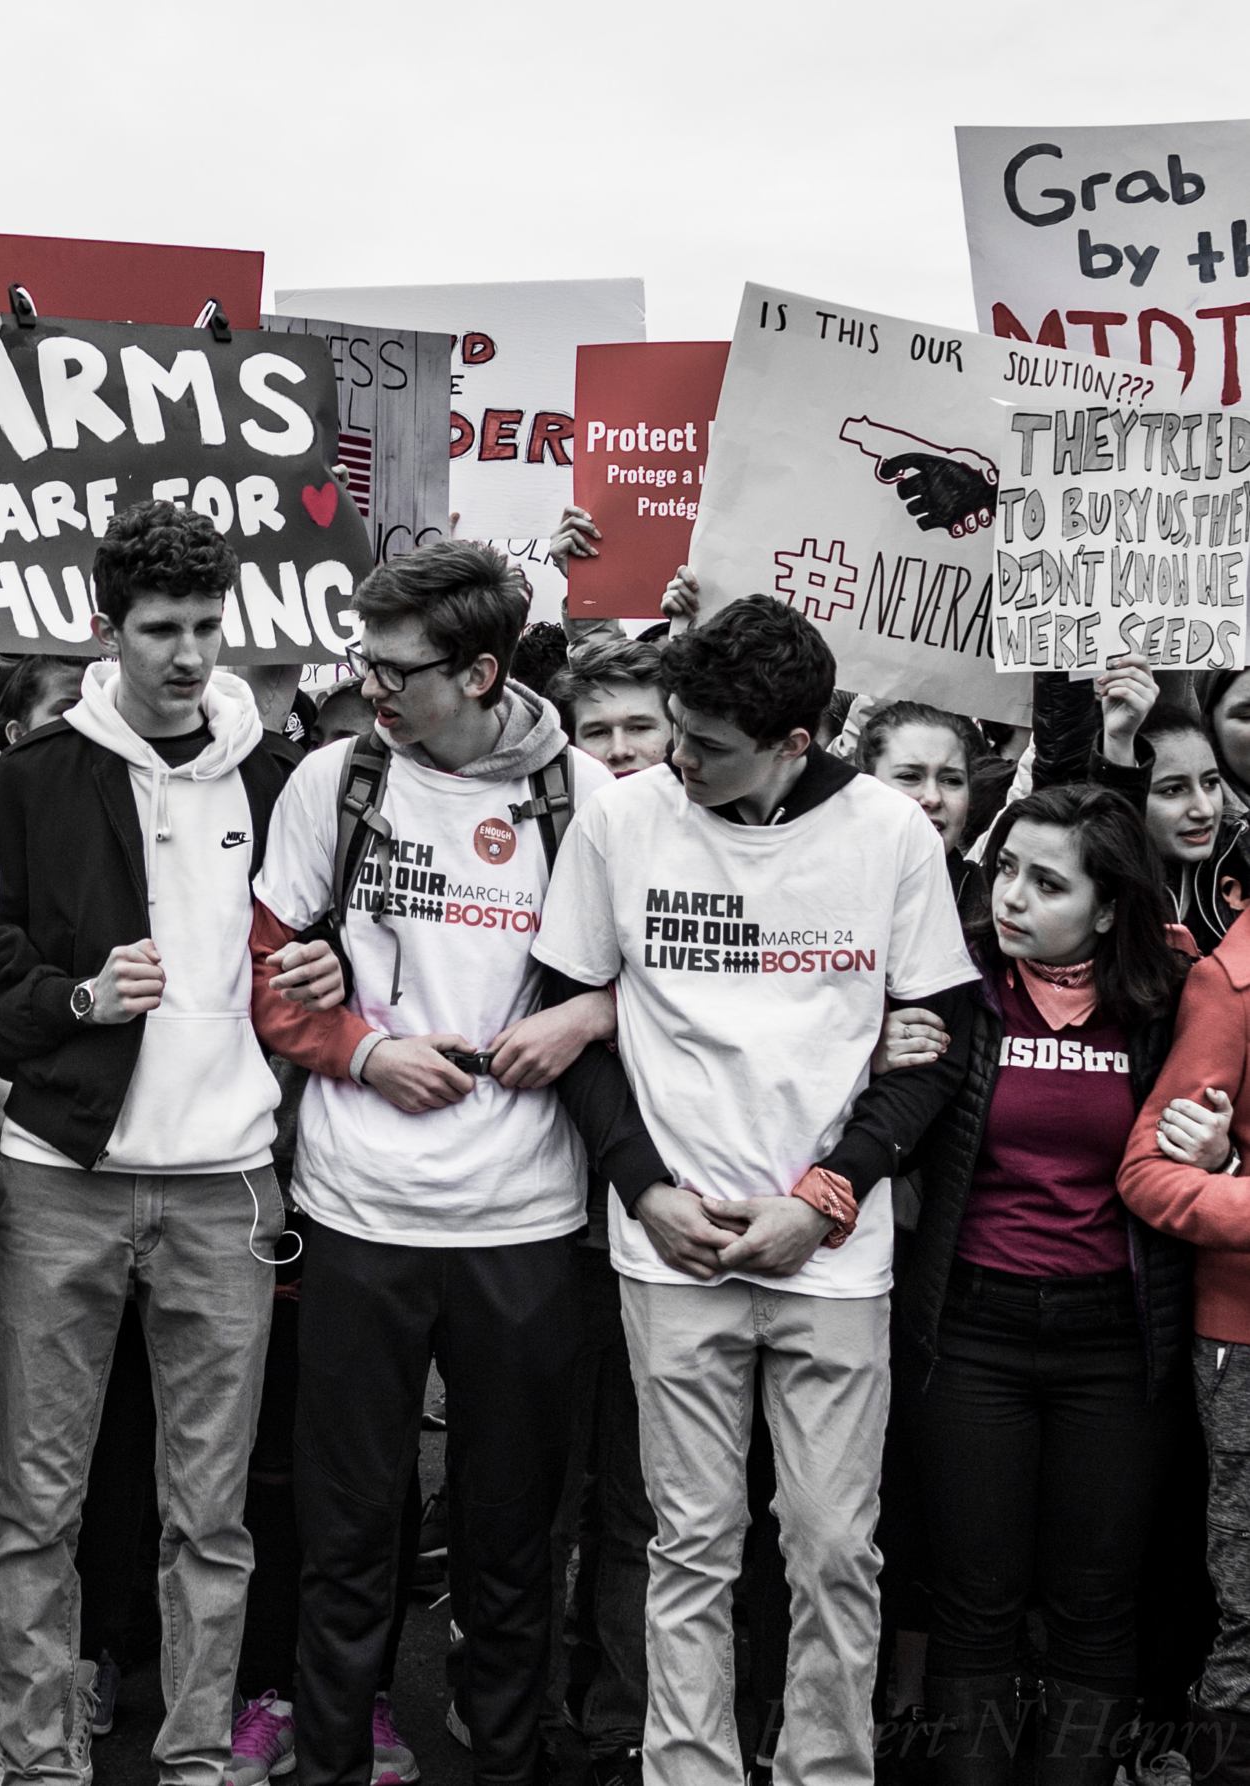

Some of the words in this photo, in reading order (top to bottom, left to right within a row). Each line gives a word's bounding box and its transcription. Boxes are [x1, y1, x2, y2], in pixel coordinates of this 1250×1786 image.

[1004, 143, 1206, 227] Grab
[1078, 229, 1160, 287] by
[760, 301, 788, 331] IS
[816, 310, 879, 354] THIS
[910, 334, 963, 373] OUR
[1004, 352, 1154, 407] SOLUTION???
[587, 421, 697, 452] Protect
[607, 464, 676, 487] Protege
[682, 470, 692, 484] a
[637, 496, 700, 520] Protég
[999, 487, 1045, 543] TO
[1062, 487, 1152, 543] BURY
[997, 544, 1104, 611] DIDN'T
[1111, 545, 1189, 607] KNOW
[1197, 552, 1244, 607] WE
[775, 538, 995, 660] #NEVERA
[997, 611, 1101, 669] WERE
[1106, 612, 1240, 670] SEEDS
[226, 831, 247, 842] NIKE
[480, 825, 512, 840] ENOUGH
[368, 839, 434, 867] ARCH
[395, 866, 446, 897] OUR
[447, 884, 510, 904] MARCH
[515, 892, 533, 907] 24
[445, 902, 542, 933] BOSTON
[646, 888, 743, 919] MARCH
[646, 916, 699, 943] FOR
[703, 921, 760, 947] OUR
[761, 931, 828, 946] MARCH
[833, 930, 854, 945] 24
[644, 944, 720, 973] LIVES
[761, 949, 876, 973] BOSTON
[999, 1036, 1130, 1073] SDStro
